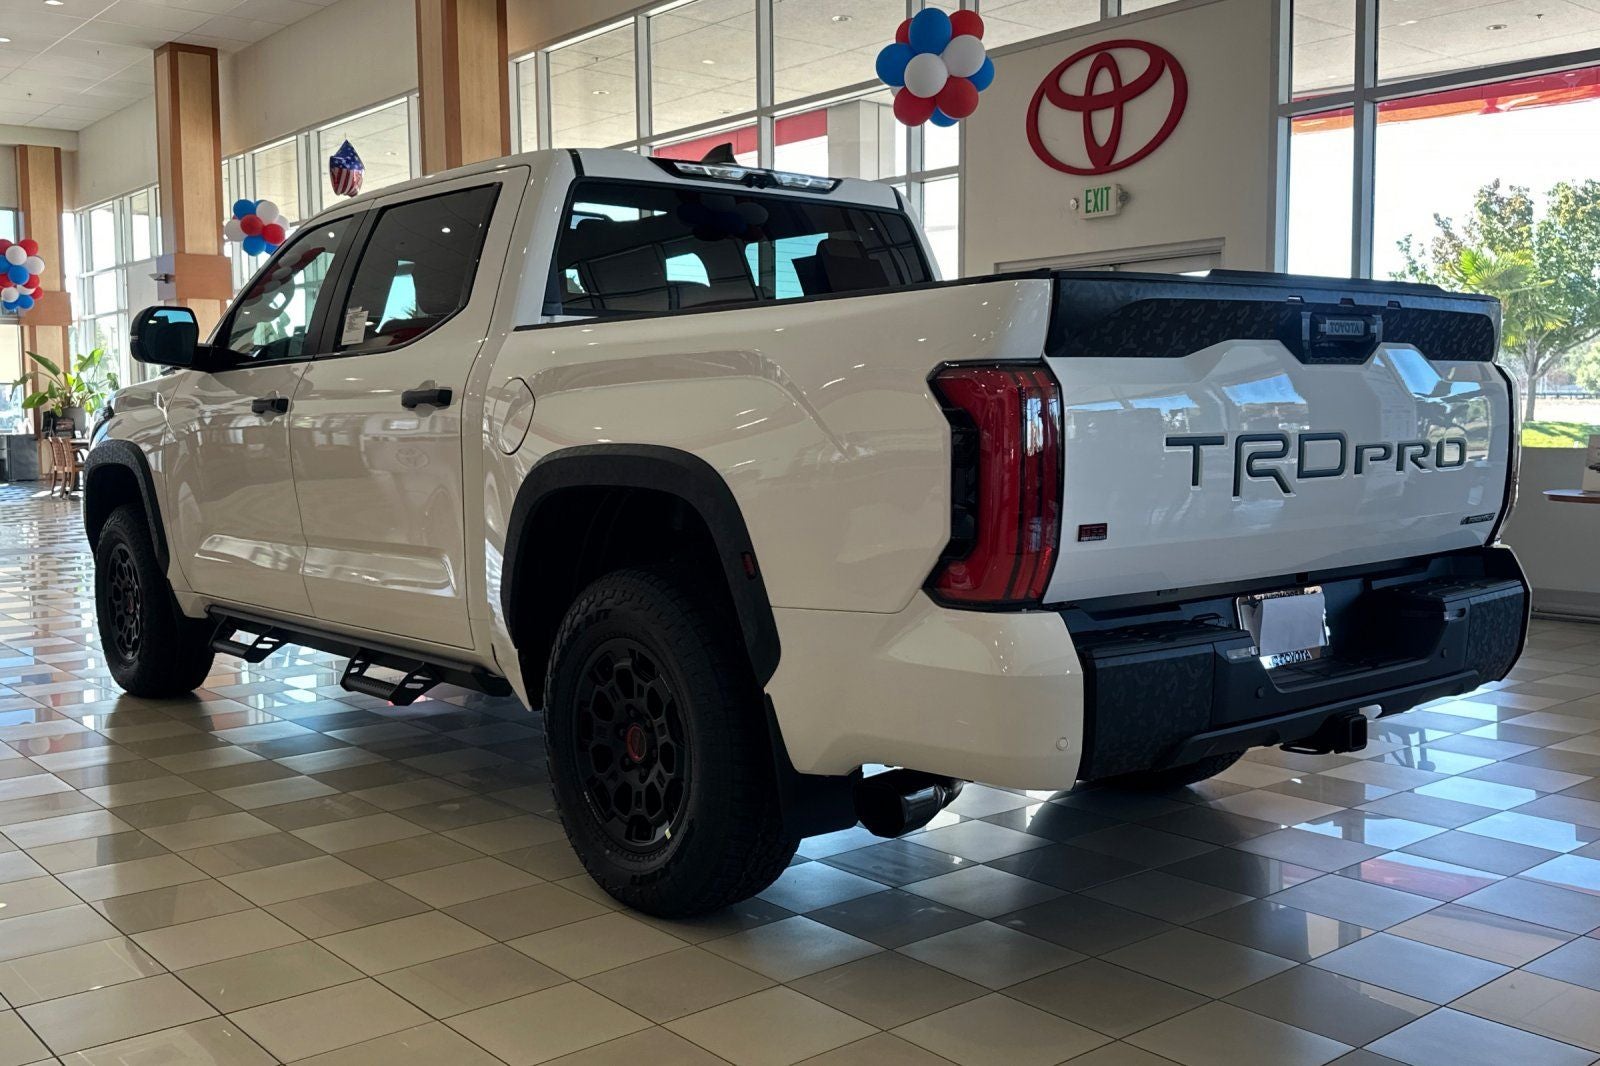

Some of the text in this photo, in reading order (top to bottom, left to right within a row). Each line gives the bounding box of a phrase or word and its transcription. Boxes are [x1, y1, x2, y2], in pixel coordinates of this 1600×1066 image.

[1085, 186, 1111, 214] EXIT
[1329, 321, 1360, 333] TOYOTA
[1165, 431, 1467, 499] TRD PRO
